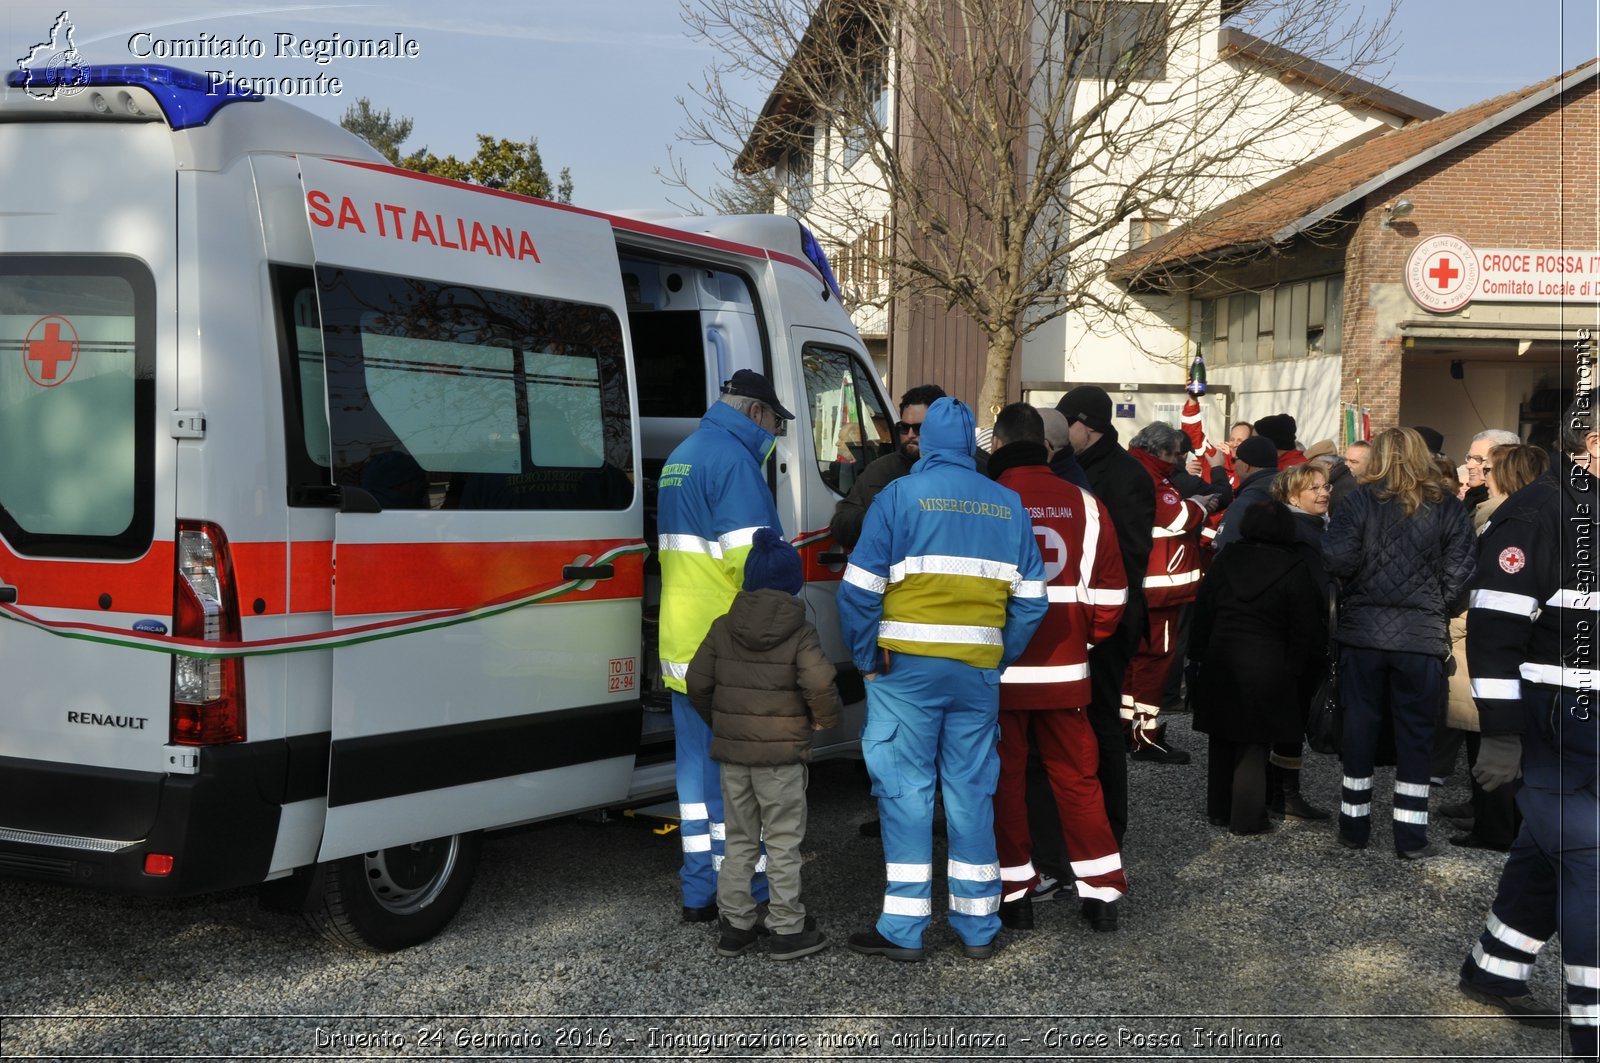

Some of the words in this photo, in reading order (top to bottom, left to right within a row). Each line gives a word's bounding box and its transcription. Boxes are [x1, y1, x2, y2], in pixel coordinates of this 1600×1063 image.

[307, 190, 367, 234] SA
[375, 202, 541, 264] ITALIANA
[1482, 254, 1530, 272] CROCE
[1536, 255, 1584, 274] ROSSA
[1482, 278, 1534, 295] Comitato
[1538, 279, 1575, 296] Locale
[1580, 281, 1590, 296] di
[918, 498, 1012, 520] MISERICORDIE
[1045, 506, 1073, 518] ITALIANA
[610, 661, 622, 673] TO
[625, 660, 633, 672] 10
[67, 711, 149, 729] RENAULT
